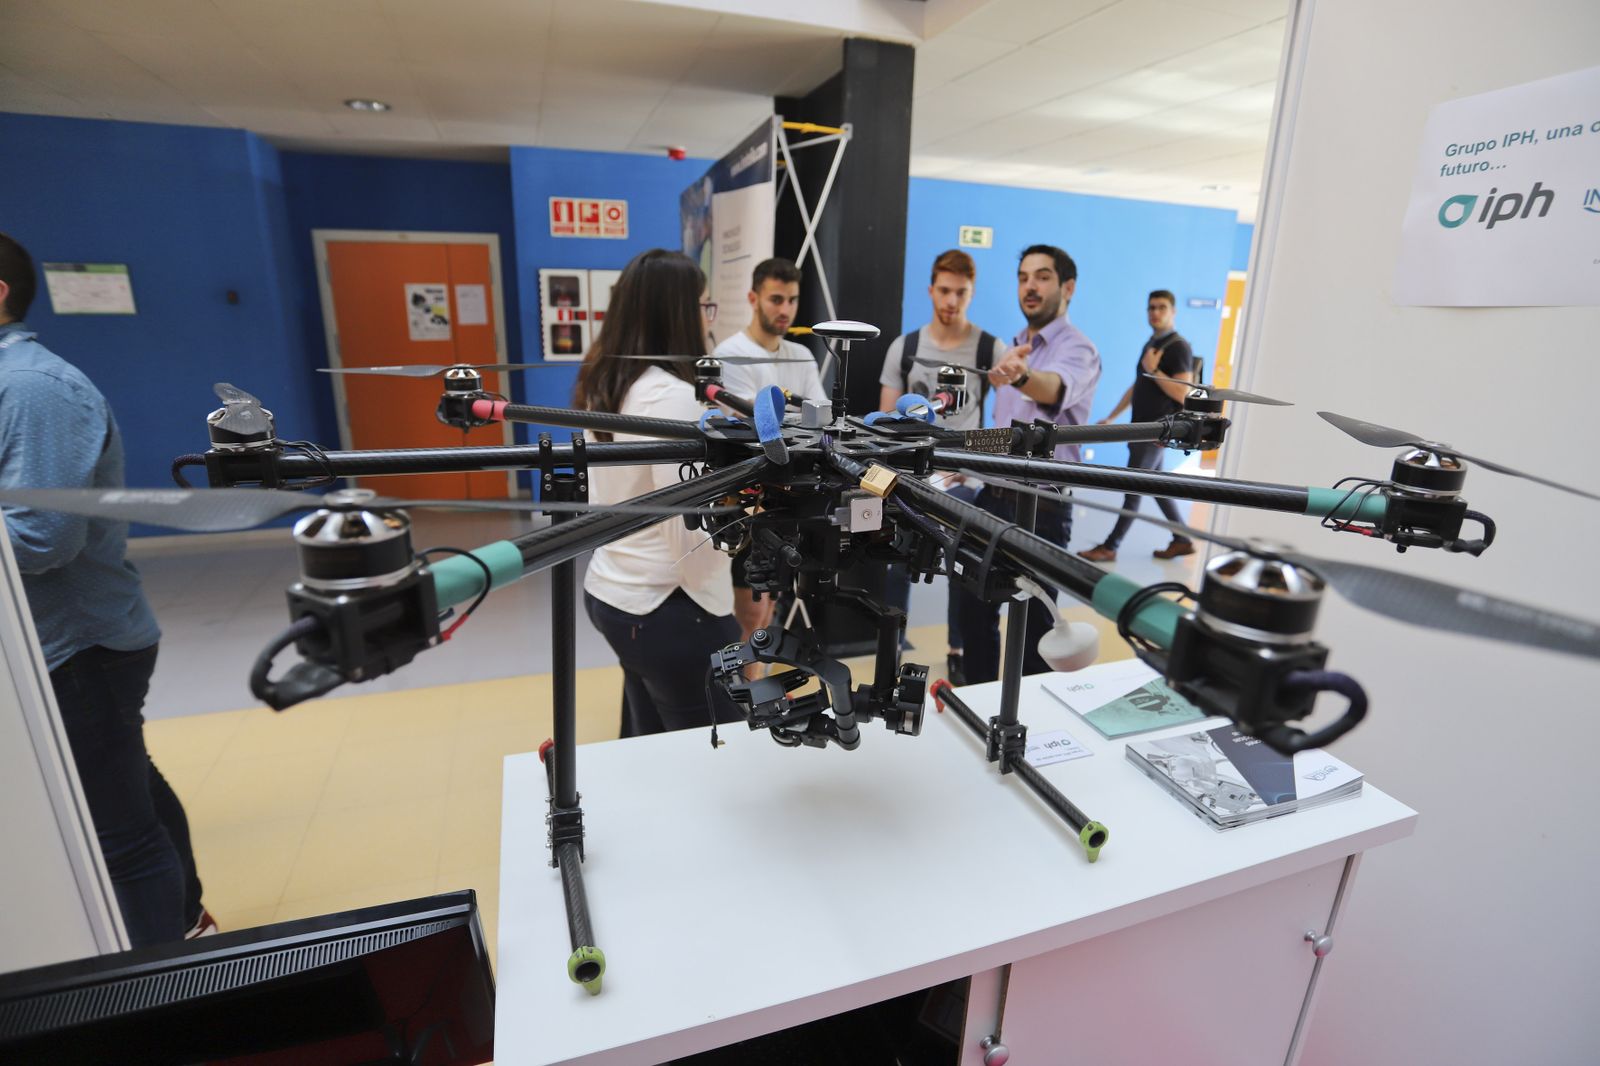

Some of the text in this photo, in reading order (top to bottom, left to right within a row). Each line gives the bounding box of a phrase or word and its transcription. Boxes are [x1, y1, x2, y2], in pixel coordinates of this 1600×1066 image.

[1444, 138, 1497, 157] Grupo
[1502, 129, 1539, 148] IPH,
[1545, 123, 1584, 141] una
[1439, 160, 1507, 177] futuro...
[1477, 181, 1555, 230] iph
